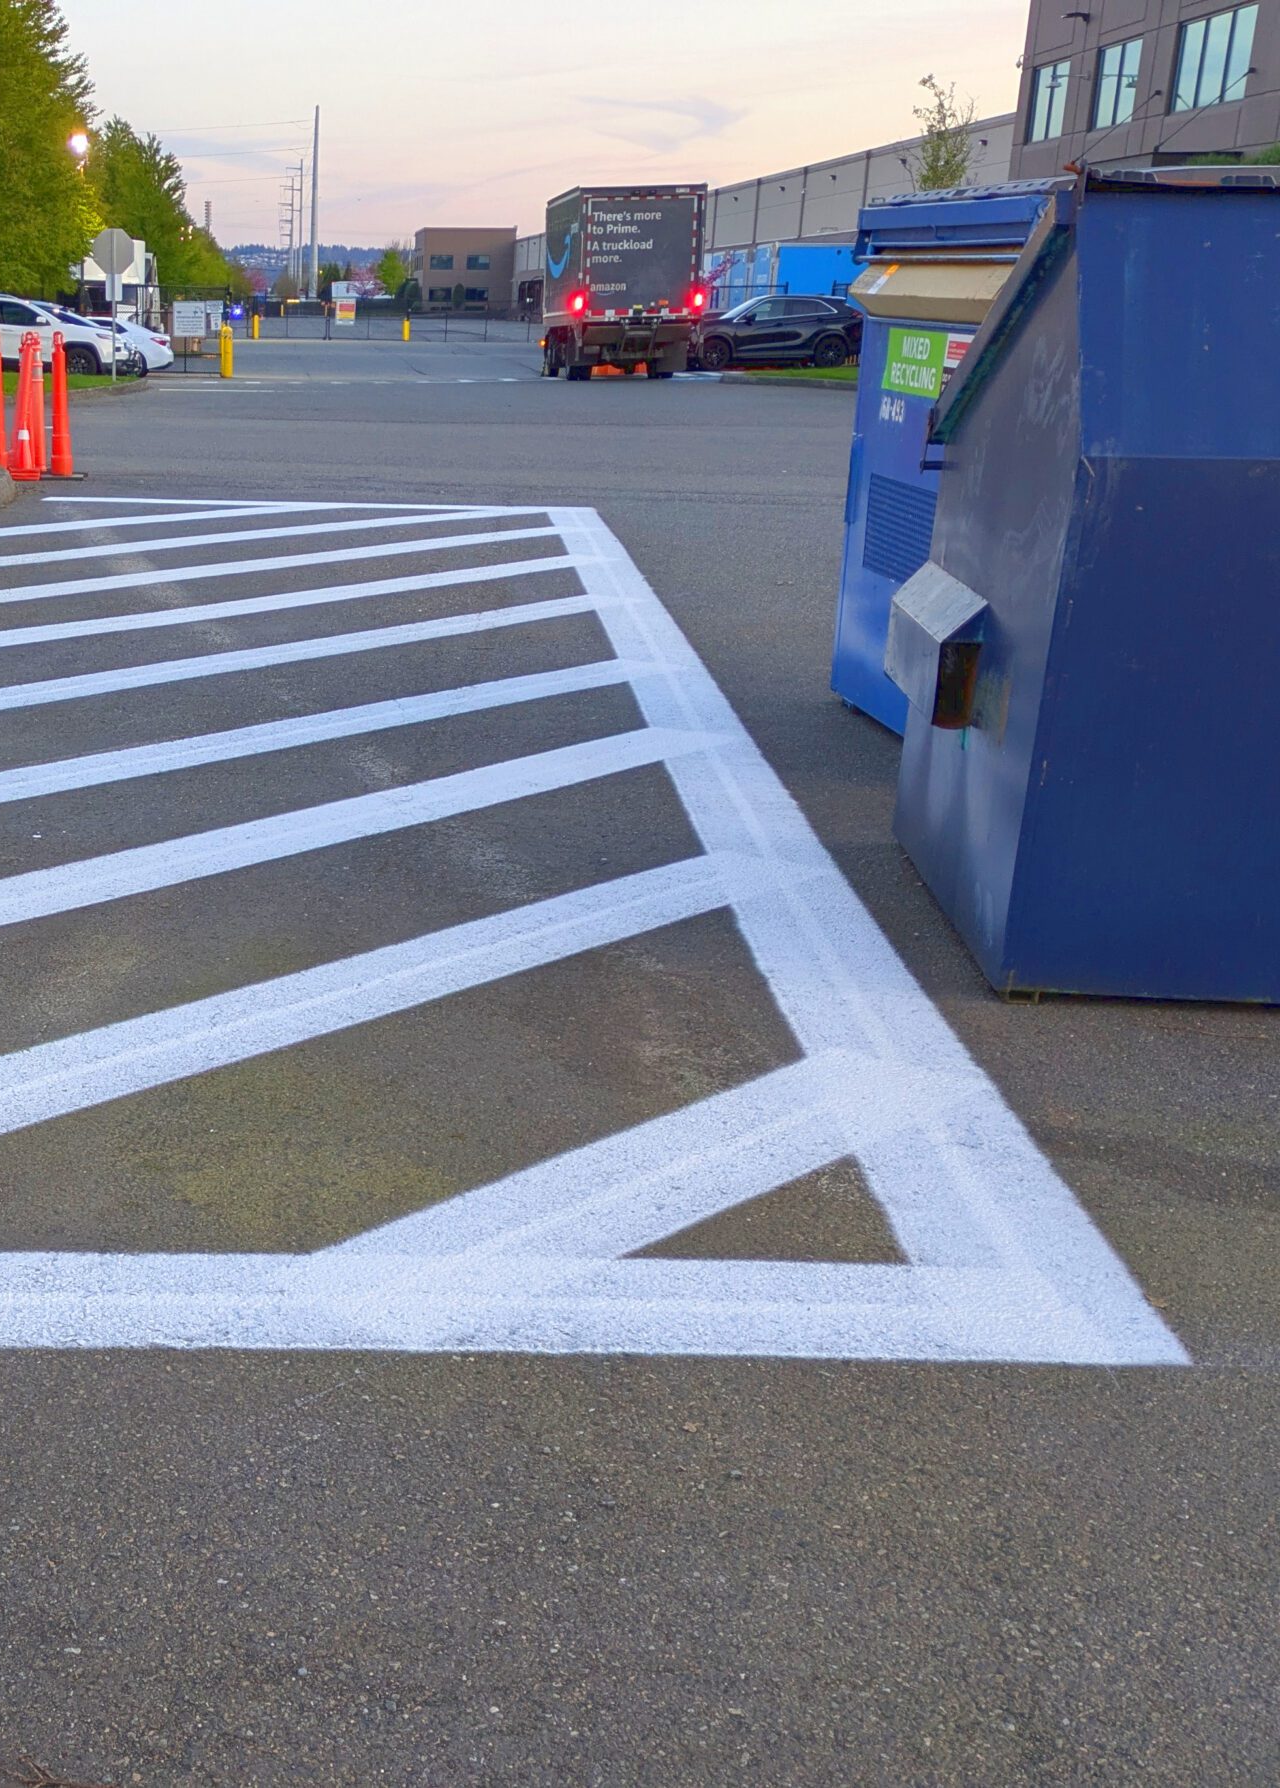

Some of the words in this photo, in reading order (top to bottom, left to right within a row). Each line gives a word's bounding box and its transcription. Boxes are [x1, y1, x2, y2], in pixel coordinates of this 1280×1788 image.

[593, 211, 632, 222] There's
[634, 211, 662, 221] more
[592, 225, 604, 235] to
[606, 223, 641, 235] Prime.
[591, 241, 600, 251] A
[602, 238, 654, 251] truckload
[591, 254, 623, 264] more.
[590, 282, 627, 293] amazon
[902, 336, 931, 360] MIXED
[891, 362, 936, 391] RECYCLING
